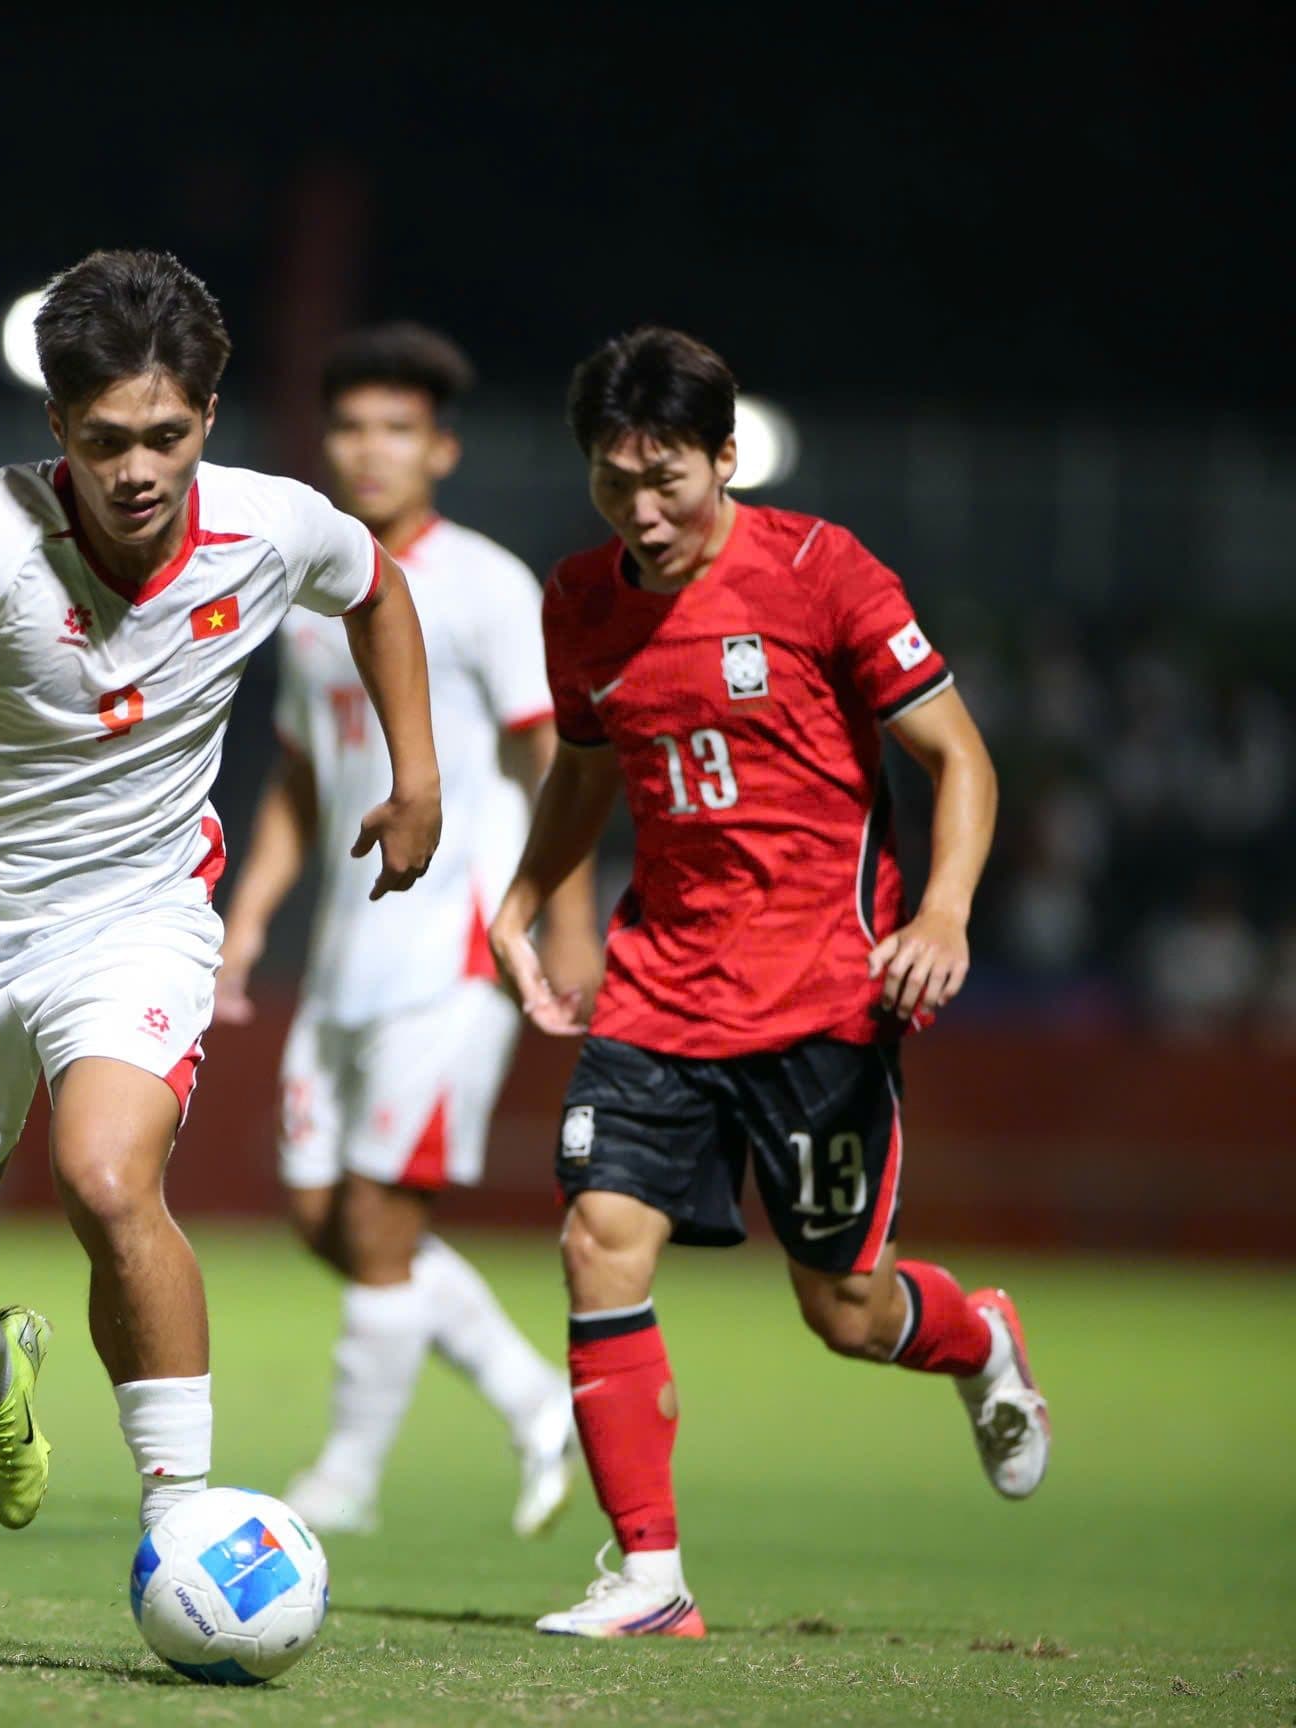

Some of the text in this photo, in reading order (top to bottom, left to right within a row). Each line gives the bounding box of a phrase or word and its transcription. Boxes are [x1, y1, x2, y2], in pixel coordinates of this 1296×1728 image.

[653, 729, 739, 814] 13
[788, 1132, 867, 1216] 13
[175, 1586, 216, 1637] molten
